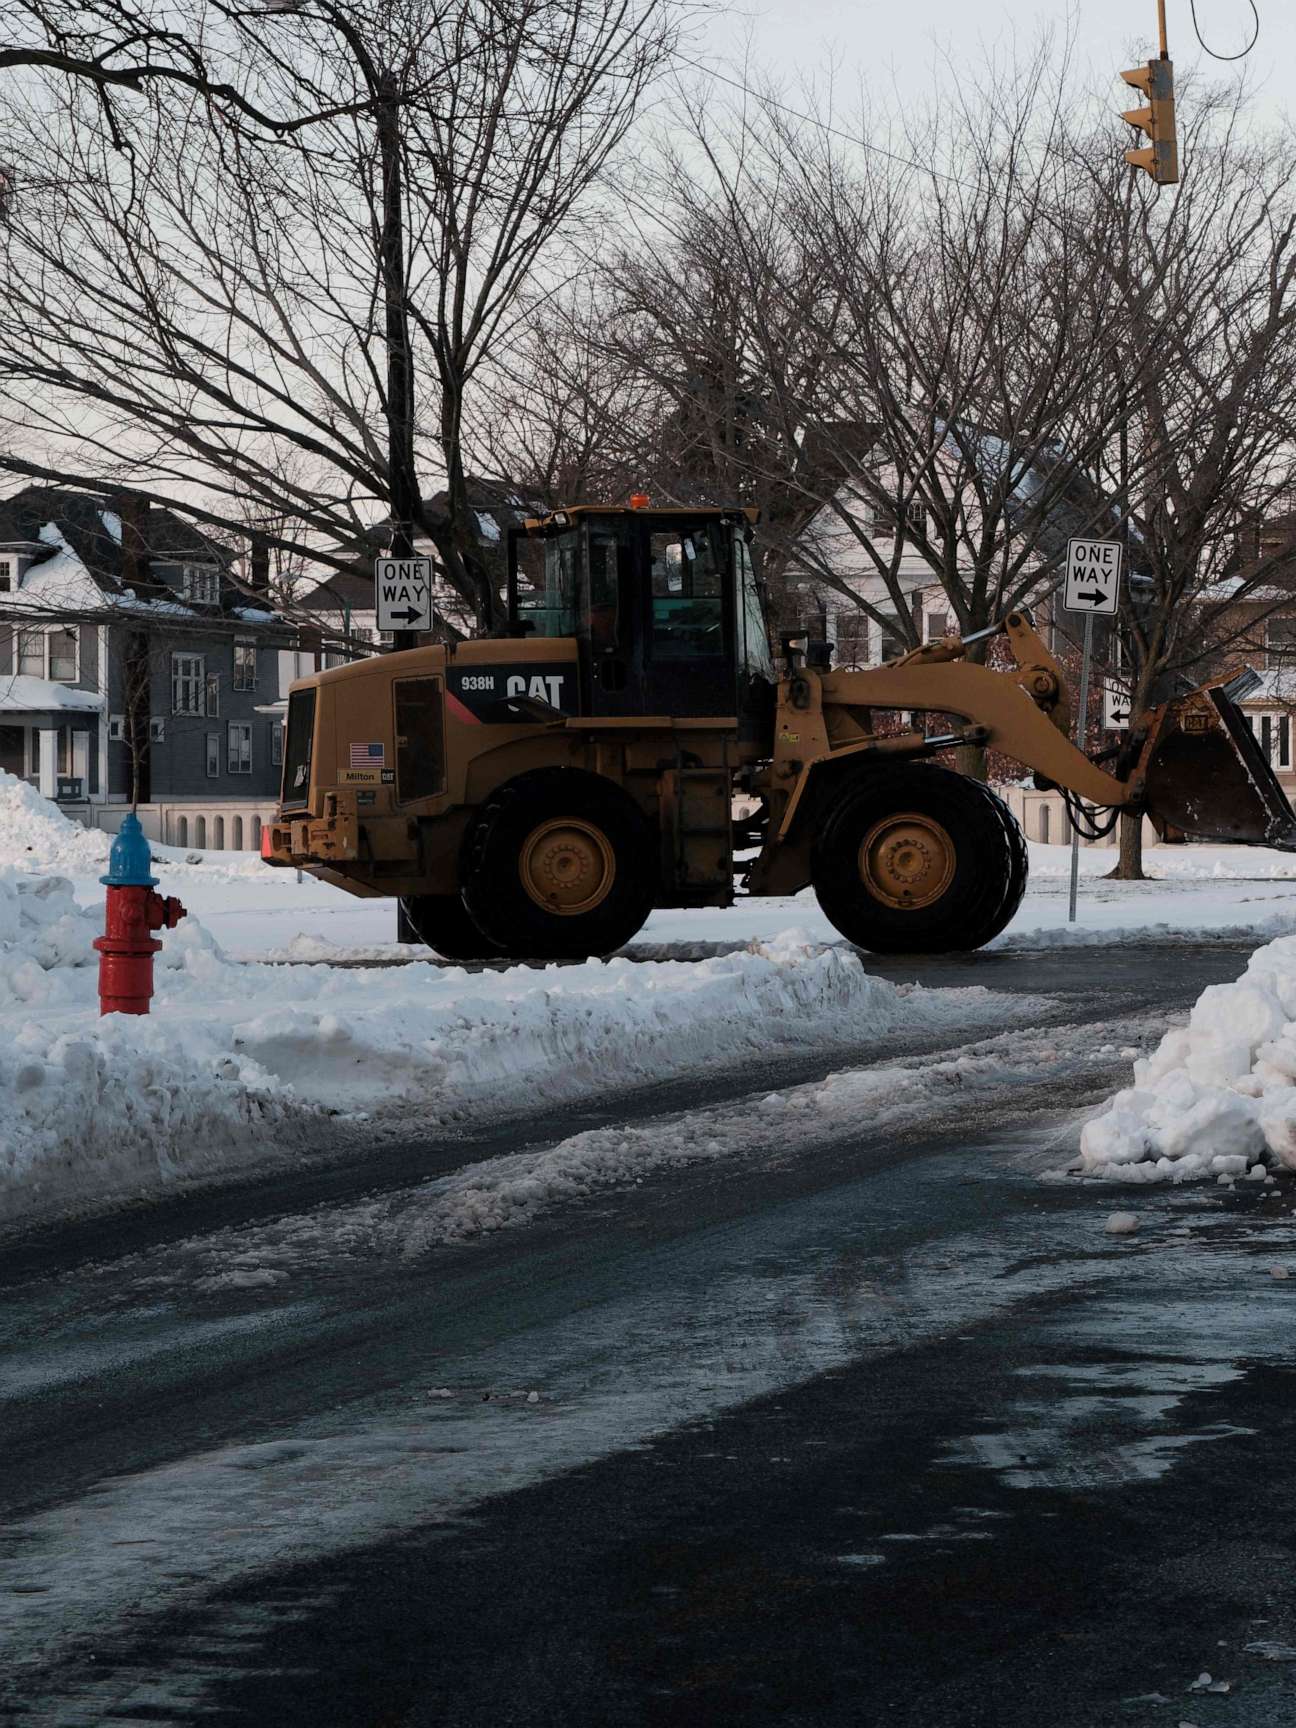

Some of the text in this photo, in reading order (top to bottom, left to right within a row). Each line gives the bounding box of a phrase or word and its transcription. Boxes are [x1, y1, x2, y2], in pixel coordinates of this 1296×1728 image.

[1075, 545, 1114, 564] ONE
[384, 563, 424, 580] ONE
[1073, 566, 1112, 584] WAY
[383, 585, 425, 602] WAY
[461, 675, 565, 712] 938H CAT
[1111, 694, 1130, 706] WA
[346, 772, 375, 781] Milton
